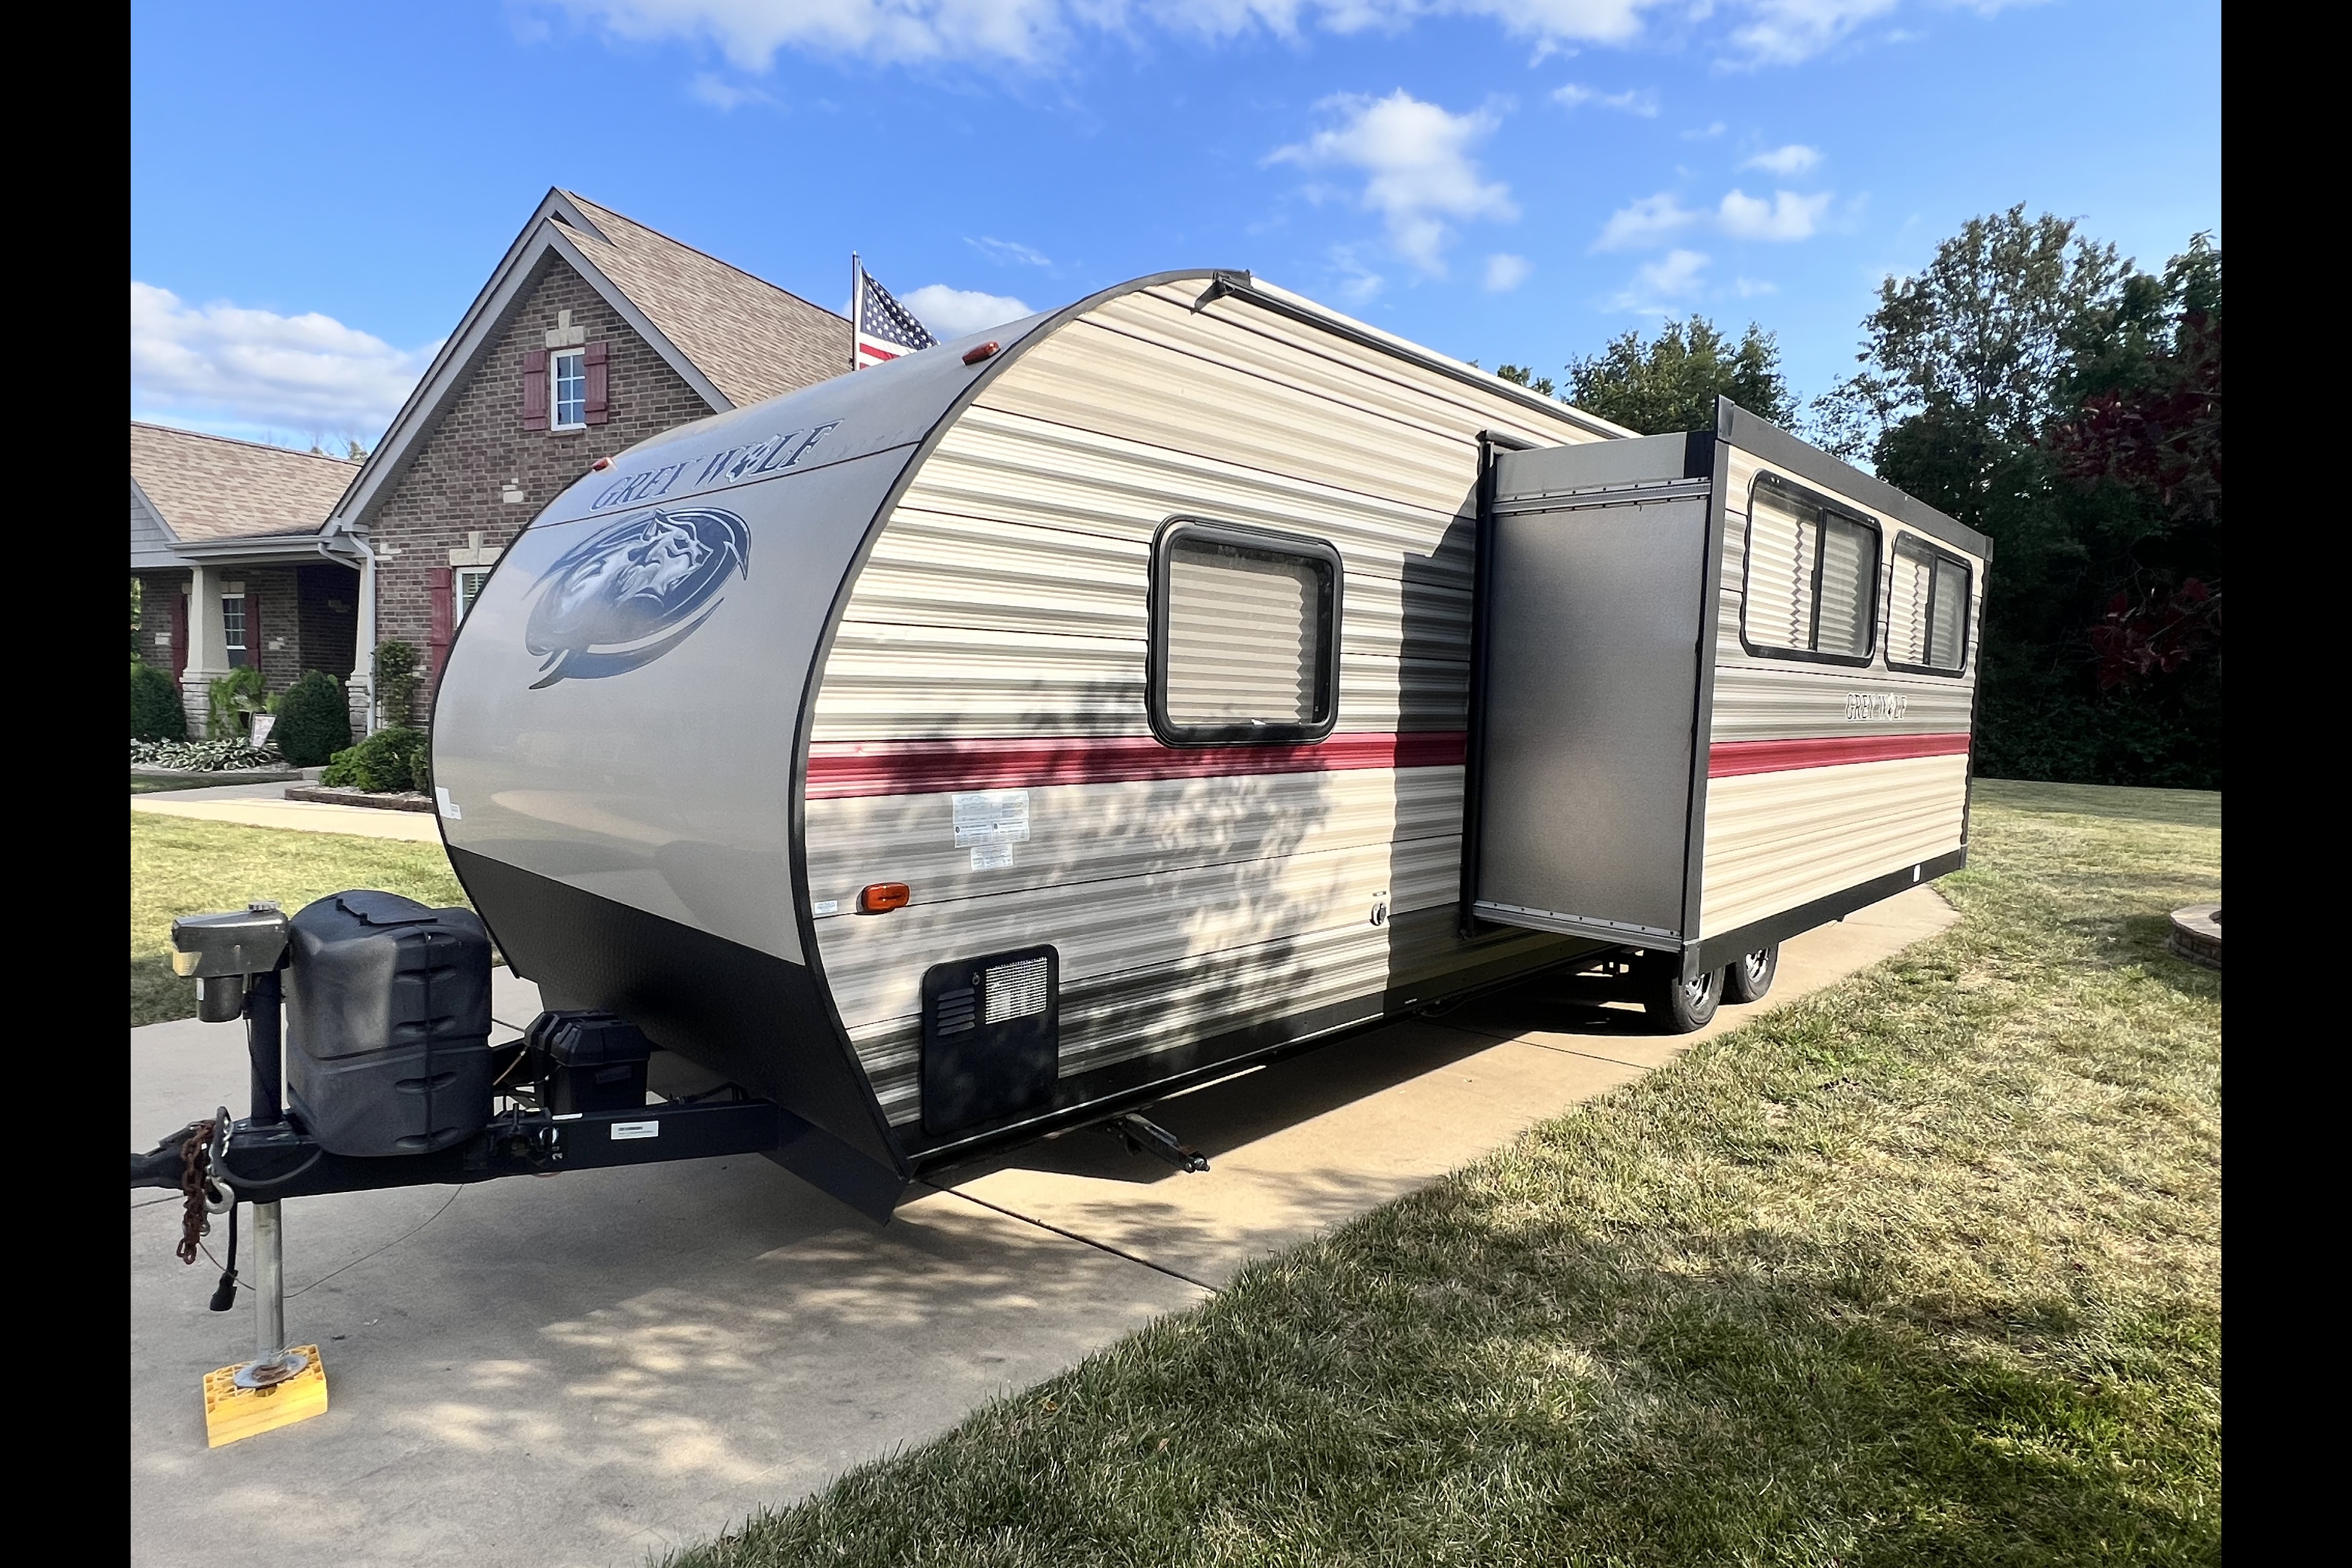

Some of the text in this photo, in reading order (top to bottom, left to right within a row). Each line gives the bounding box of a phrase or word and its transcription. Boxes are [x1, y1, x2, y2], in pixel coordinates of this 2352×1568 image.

[590, 418, 845, 512] GREY WOLF
[1845, 692, 1877, 721] GREY
